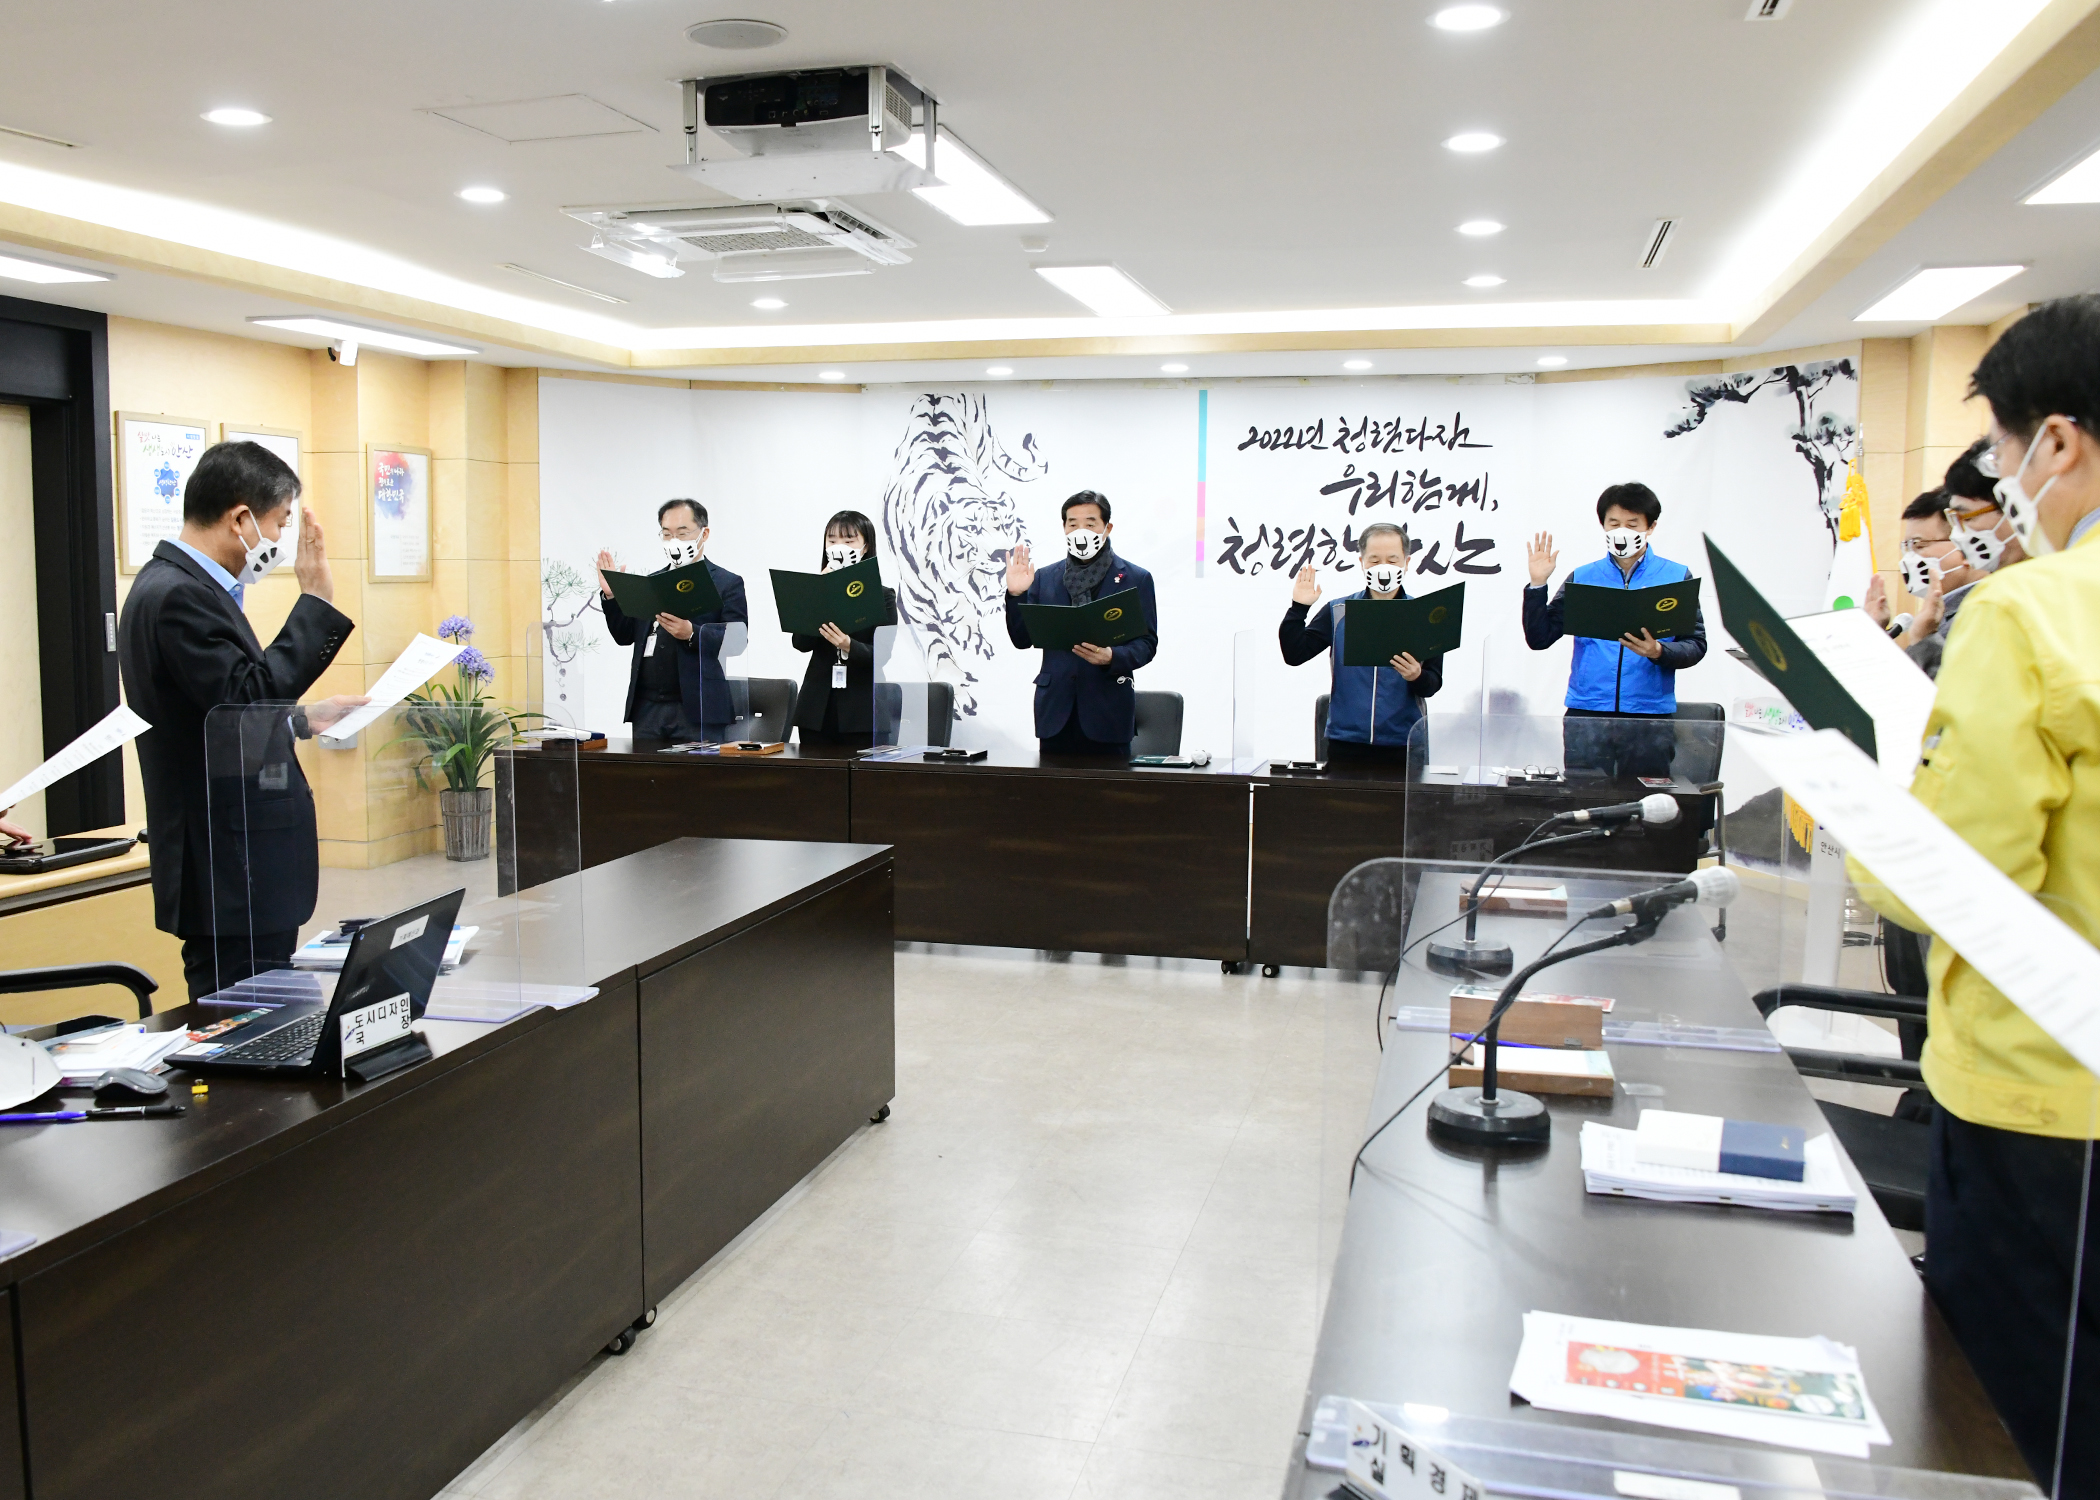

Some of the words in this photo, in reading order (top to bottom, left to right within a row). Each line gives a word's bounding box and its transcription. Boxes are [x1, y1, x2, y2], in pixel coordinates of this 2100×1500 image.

[1237, 418, 1329, 451] 2022년
[1332, 411, 1493, 454] 청렴다짐
[378, 488, 405, 503] 대한민국
[1820, 841, 1841, 859] 안산시
[355, 997, 409, 1029] 도시디자인
